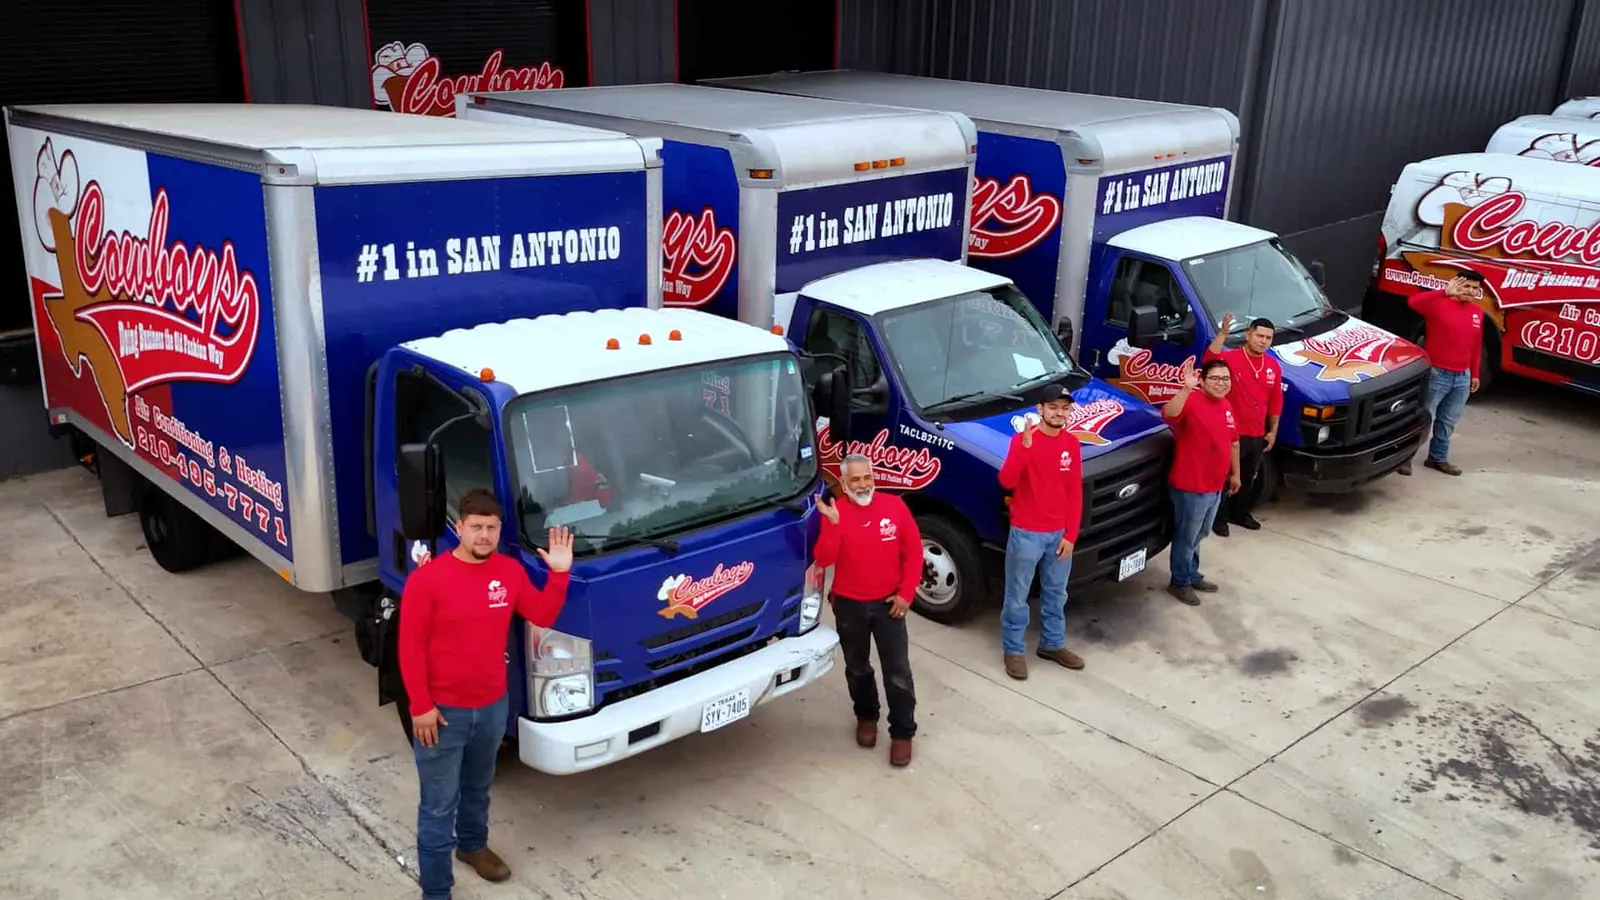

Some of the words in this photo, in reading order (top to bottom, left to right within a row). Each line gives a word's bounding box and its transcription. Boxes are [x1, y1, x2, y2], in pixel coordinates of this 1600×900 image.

[1102, 181, 1123, 215] #1
[1125, 178, 1139, 211] in
[1142, 171, 1170, 207] SAN
[1169, 161, 1226, 200] ANTONIO
[789, 214, 815, 254] #1
[819, 211, 839, 247] in
[843, 204, 878, 244] SAN
[881, 192, 954, 238] ANTONIO
[73, 180, 259, 342] Cowboys
[357, 244, 399, 282] #1
[406, 241, 439, 279] in
[446, 235, 501, 275] SAN
[510, 226, 621, 269] ANTONIO
[1500, 267, 1541, 290] Doing
[1559, 303, 1581, 321] Air
[208, 343, 224, 370] Way
[135, 395, 150, 423] Air
[153, 405, 215, 468] Conditioning
[219, 446, 232, 474] &
[235, 455, 284, 512] Heating
[900, 424, 955, 451] TACLB2717C
[137, 426, 288, 546] 210-495-7771
[673, 561, 755, 600] Cowboys
